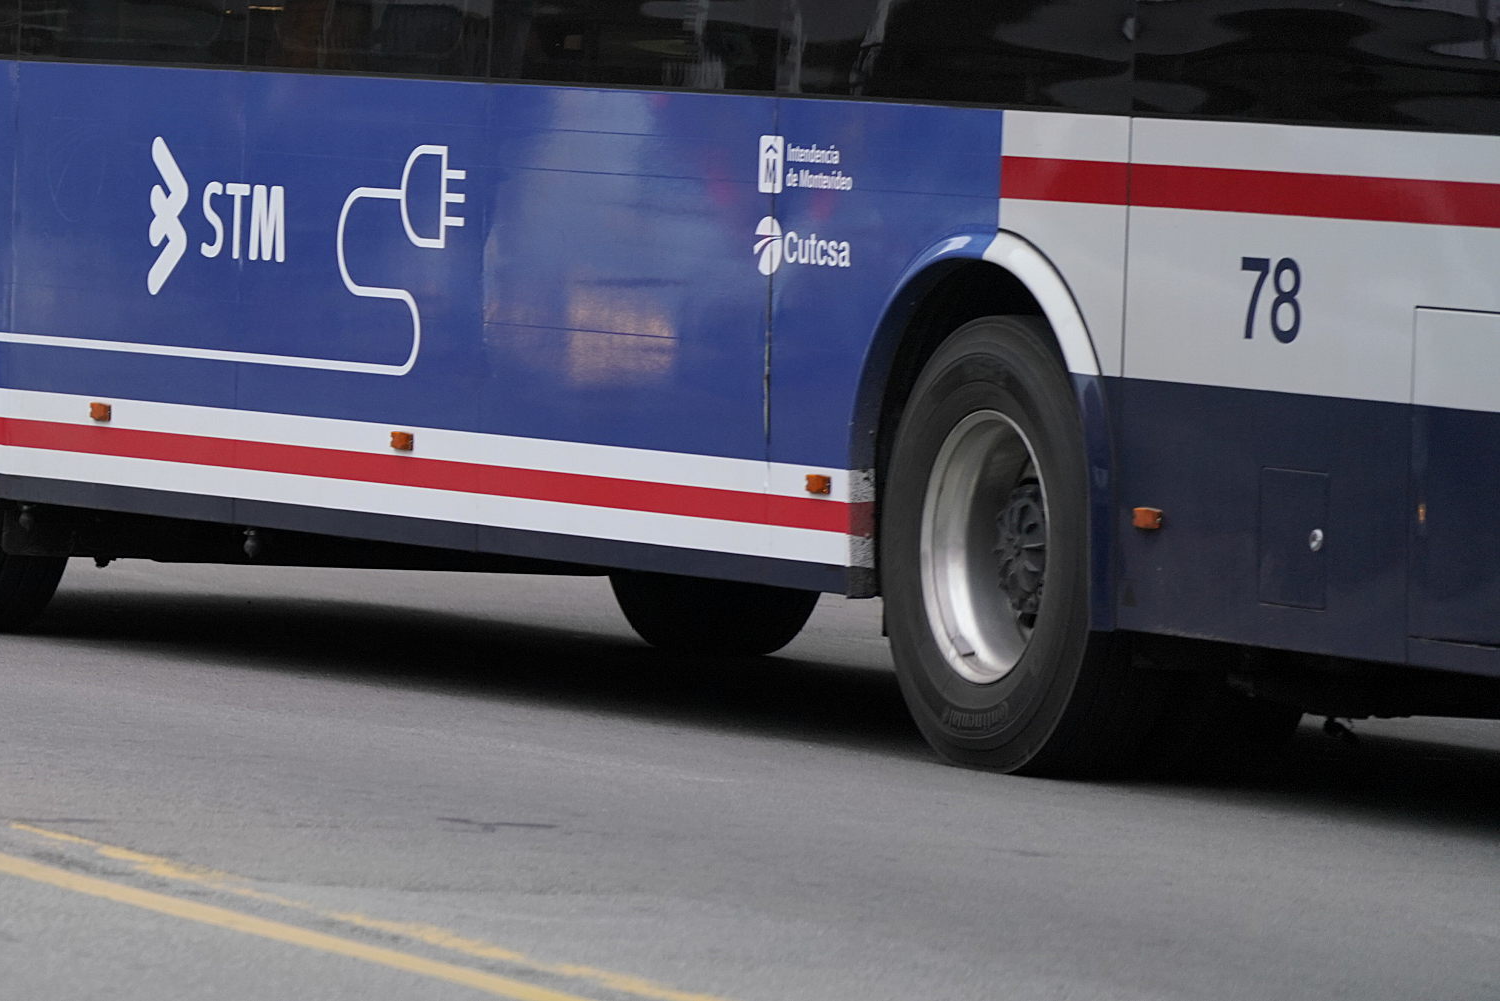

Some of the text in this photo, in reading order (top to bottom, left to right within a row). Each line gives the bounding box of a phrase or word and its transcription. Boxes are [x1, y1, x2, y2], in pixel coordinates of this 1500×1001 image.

[787, 143, 840, 164] Intendencia
[786, 168, 853, 190] de Montevideo
[201, 181, 285, 263] STM
[783, 231, 851, 268] Cutcsa
[1241, 256, 1301, 344] 78
